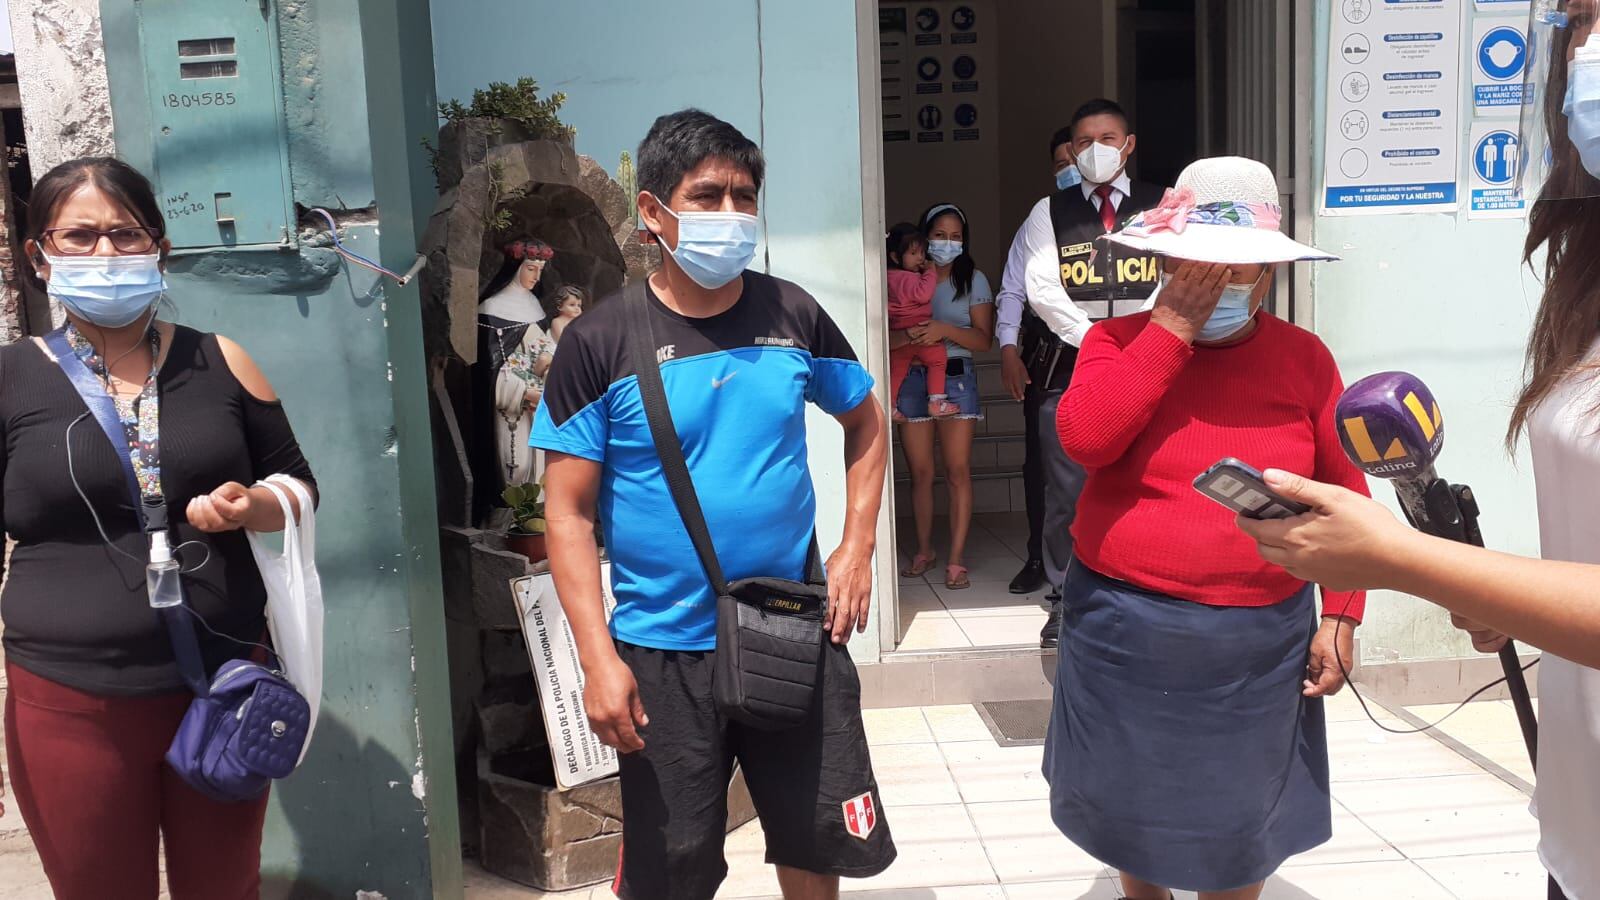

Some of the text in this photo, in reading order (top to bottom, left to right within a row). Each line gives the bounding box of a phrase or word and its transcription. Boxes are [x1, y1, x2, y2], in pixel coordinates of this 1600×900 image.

[162, 92, 236, 108] 1804585
[1364, 193, 1399, 202] SEGURIDAD
[1416, 191, 1445, 200] NUESTRA
[1366, 461, 1417, 474] Latina
[533, 609, 544, 627] DEL
[537, 627, 555, 668] NACIONAL
[549, 668, 564, 702] POLICIA
[557, 703, 566, 715] LA
[570, 690, 582, 720] PERSONAS
[559, 714, 569, 727] DE
